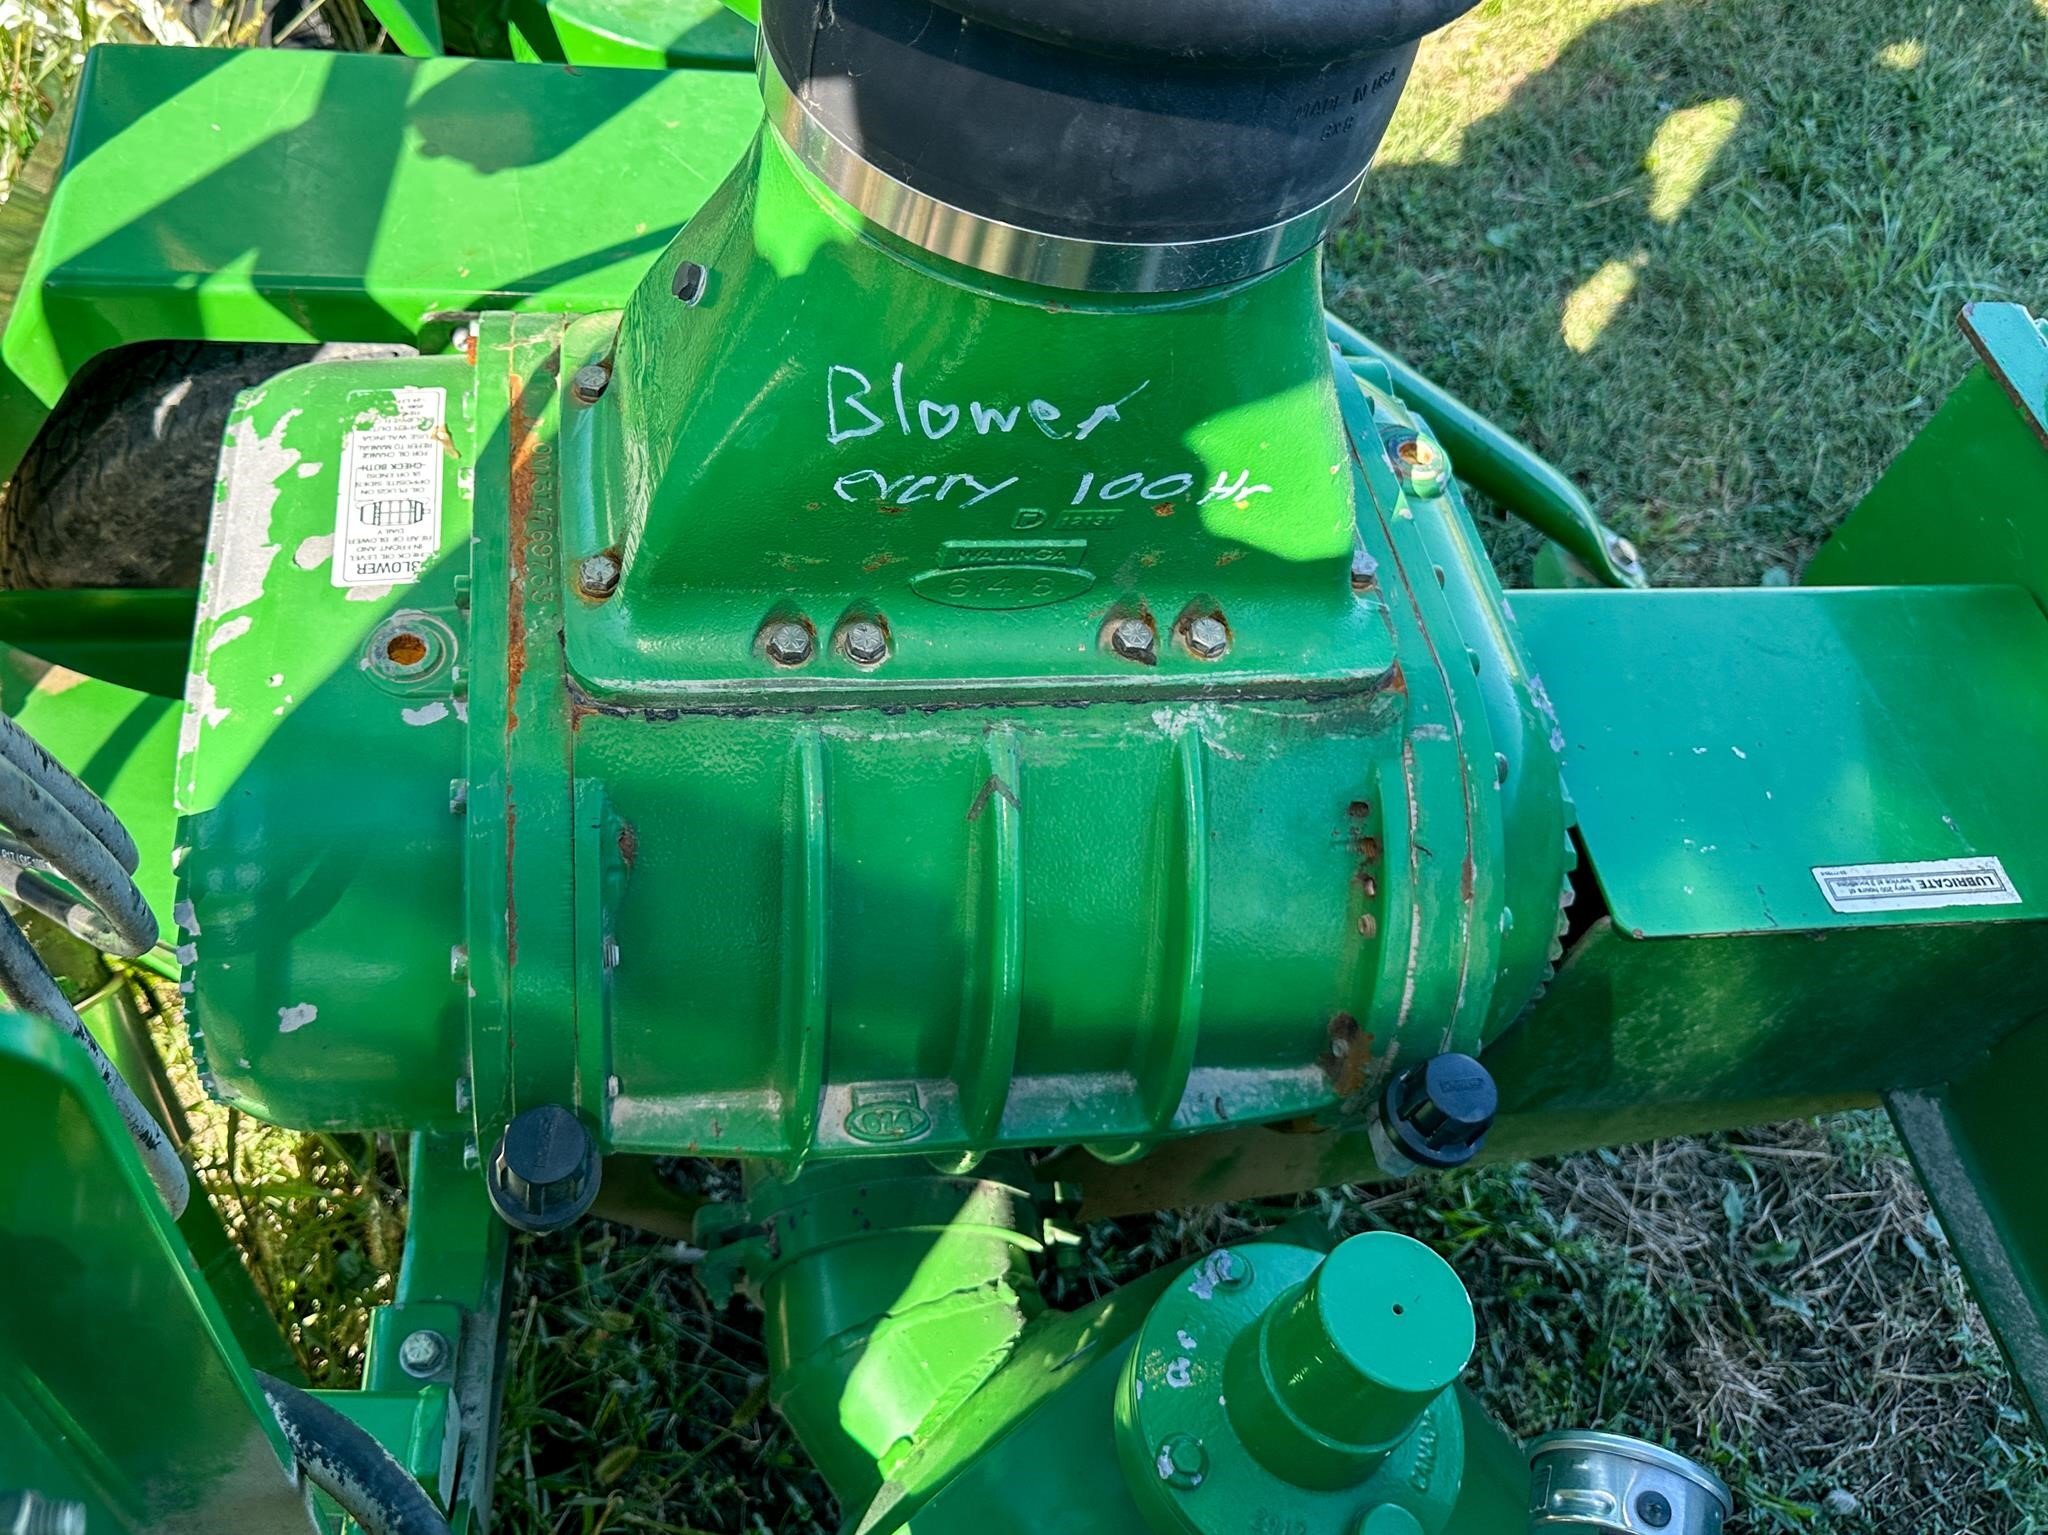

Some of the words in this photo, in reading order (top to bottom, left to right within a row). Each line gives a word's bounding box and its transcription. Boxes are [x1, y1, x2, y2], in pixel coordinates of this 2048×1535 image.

[827, 362, 1150, 445] Blower
[1071, 472, 1194, 505] 100
[348, 537, 390, 545] BLOWER
[955, 547, 1068, 563] WALINGA
[1918, 875, 1995, 890] LUBRICATE
